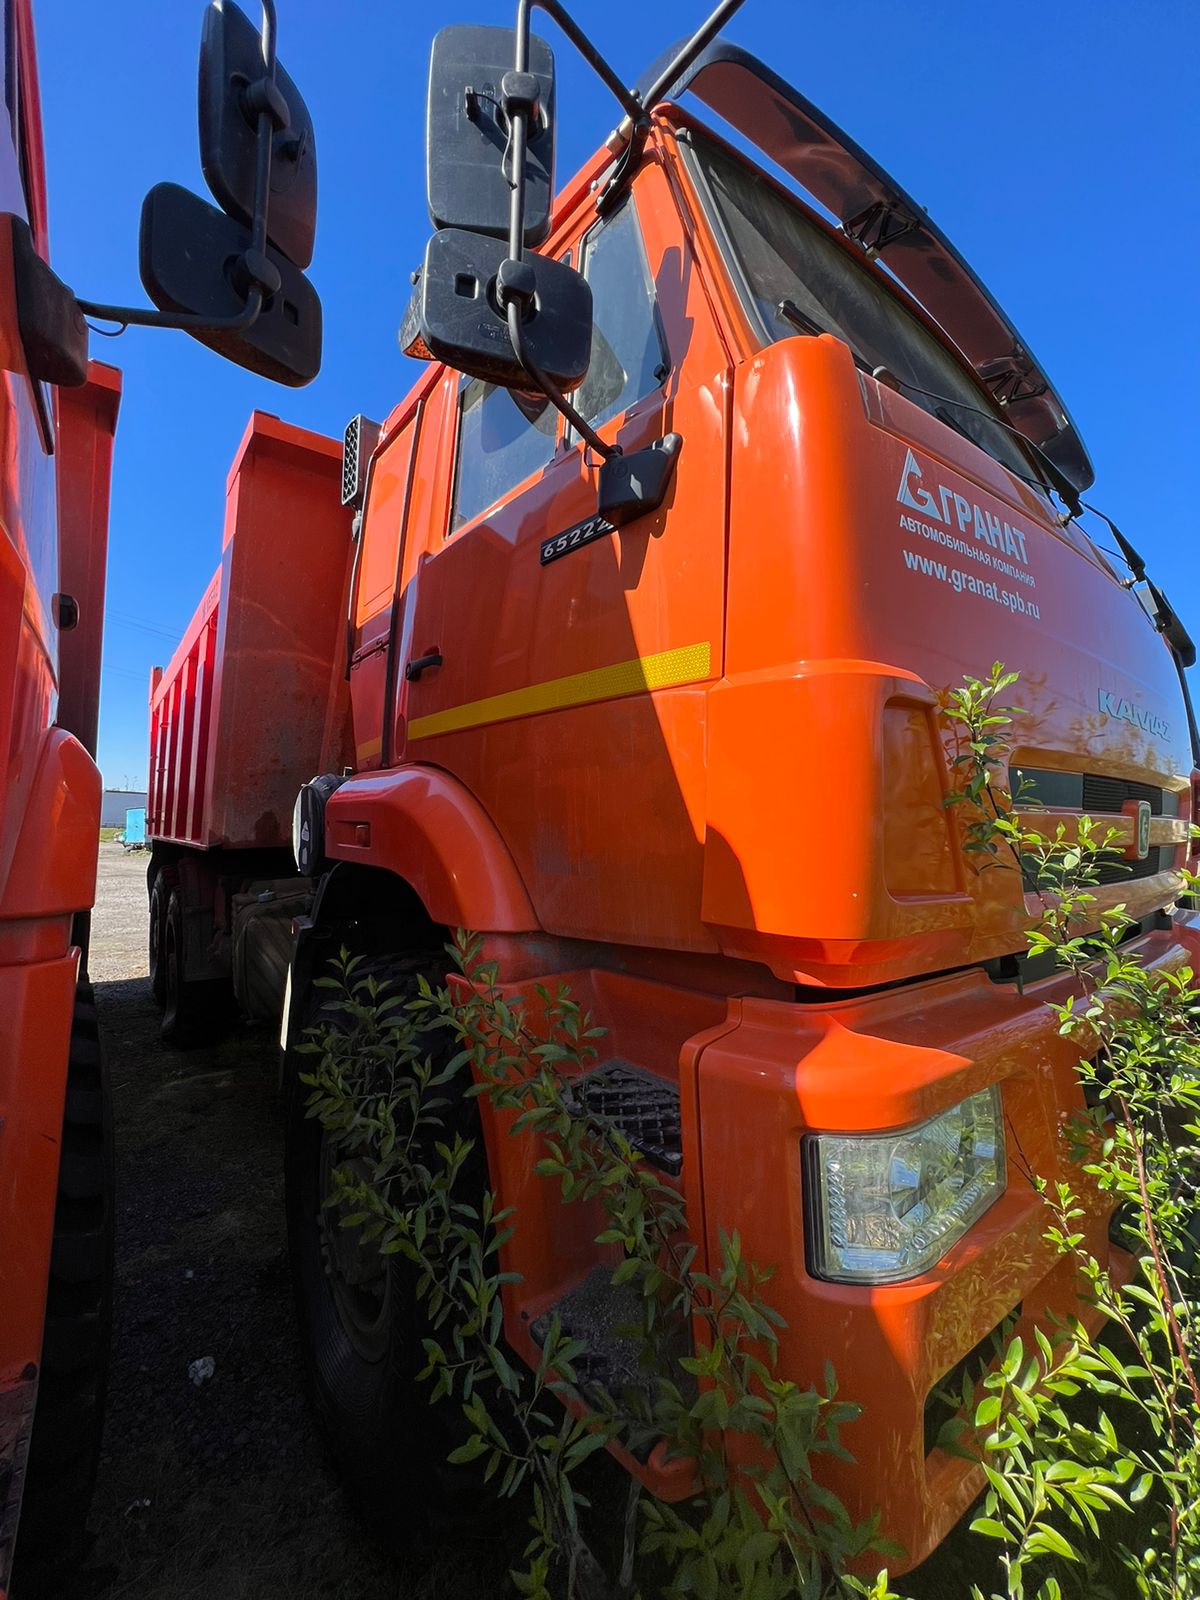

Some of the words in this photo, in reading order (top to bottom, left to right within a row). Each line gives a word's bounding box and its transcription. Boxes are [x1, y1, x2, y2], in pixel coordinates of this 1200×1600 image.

[899, 514, 992, 566] АВТОМОБИЛЬНАЯ
[992, 556, 1036, 588] КОМПАНИЯ
[938, 484, 1028, 565] ГРАНАТ
[903, 550, 1041, 620] www.granat.spb.ru
